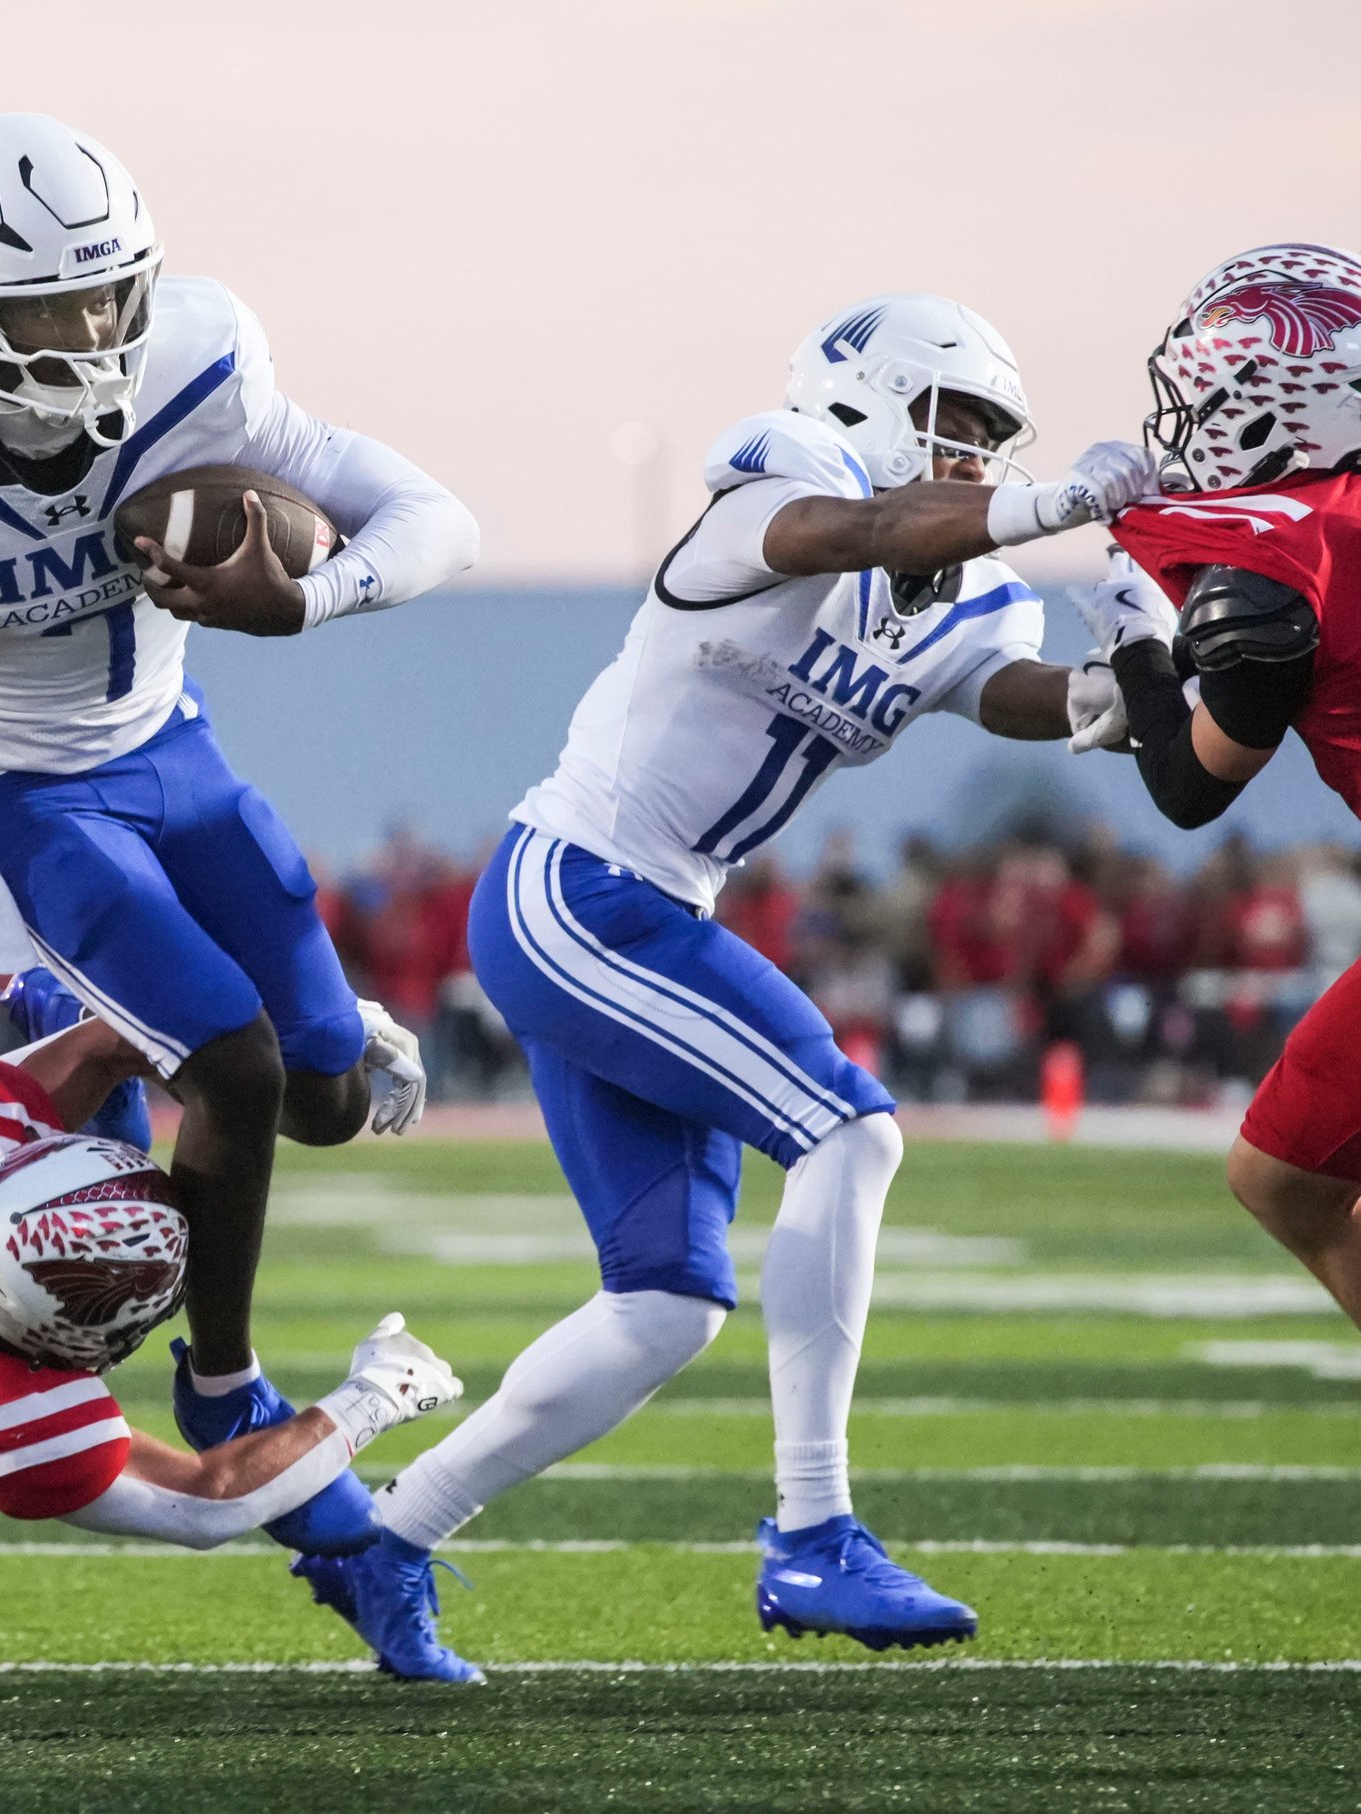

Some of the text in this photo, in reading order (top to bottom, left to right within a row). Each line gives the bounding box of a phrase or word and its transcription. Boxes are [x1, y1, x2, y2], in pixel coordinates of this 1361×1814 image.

[74, 238, 122, 264] IMGA
[40, 598, 136, 703] 7
[788, 627, 922, 738] IMG
[765, 682, 885, 754] ACADEMY
[690, 712, 841, 864] 11
